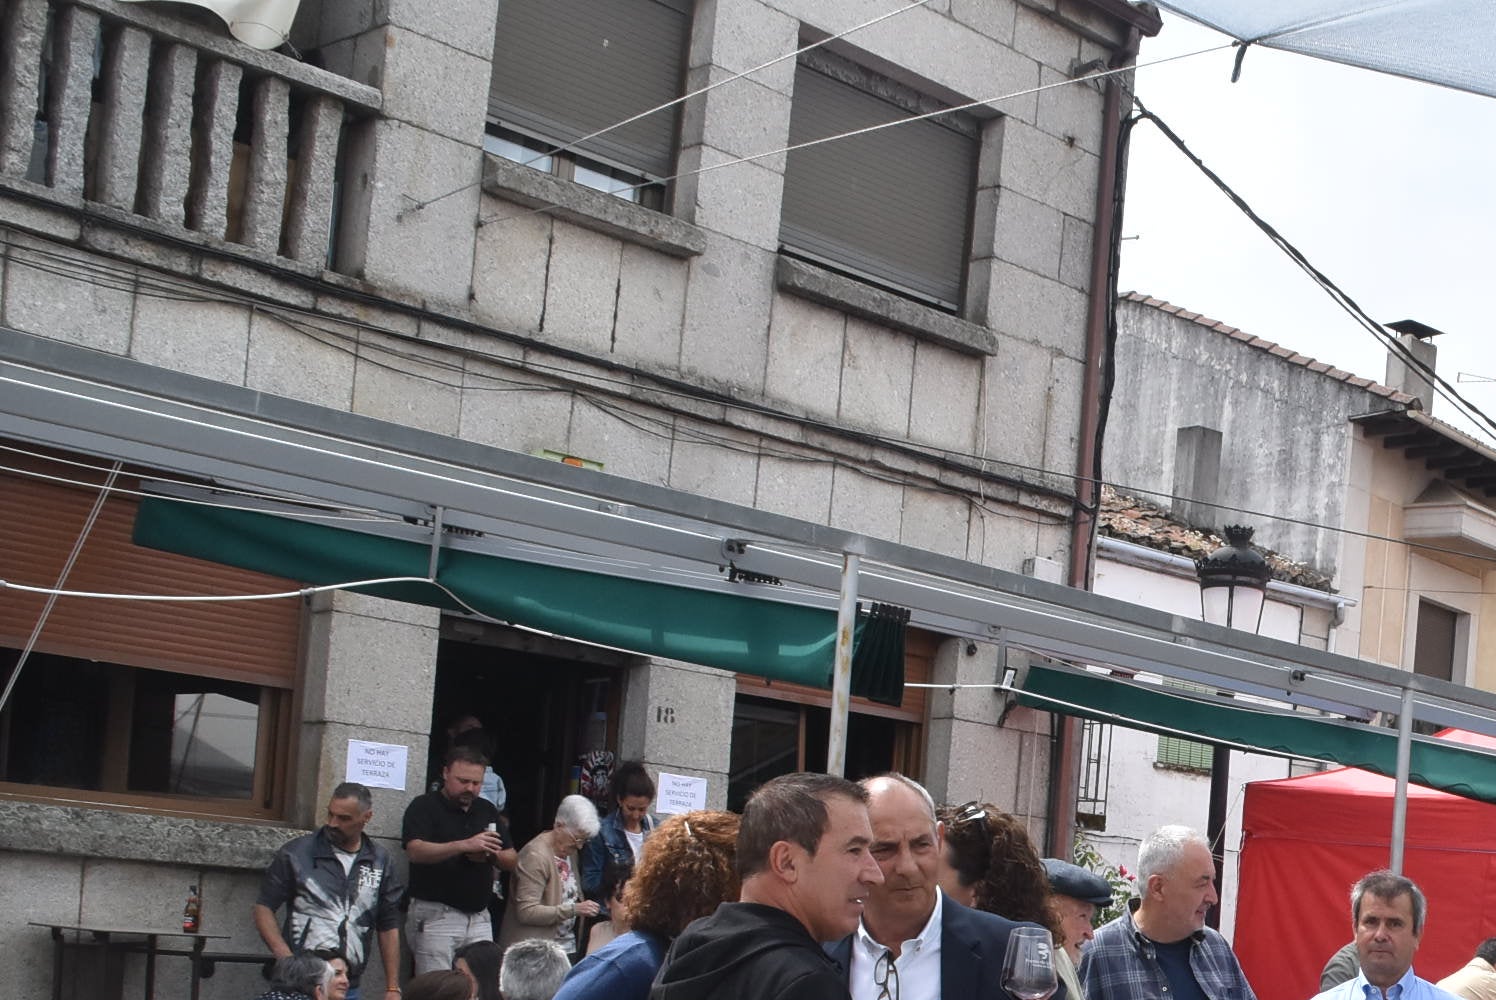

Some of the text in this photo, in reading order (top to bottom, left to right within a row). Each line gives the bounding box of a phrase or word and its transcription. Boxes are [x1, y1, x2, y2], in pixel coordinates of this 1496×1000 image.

[657, 706, 675, 723] 18
[357, 758, 386, 767] SERVICIO
[362, 769, 390, 777] TERRAZA
